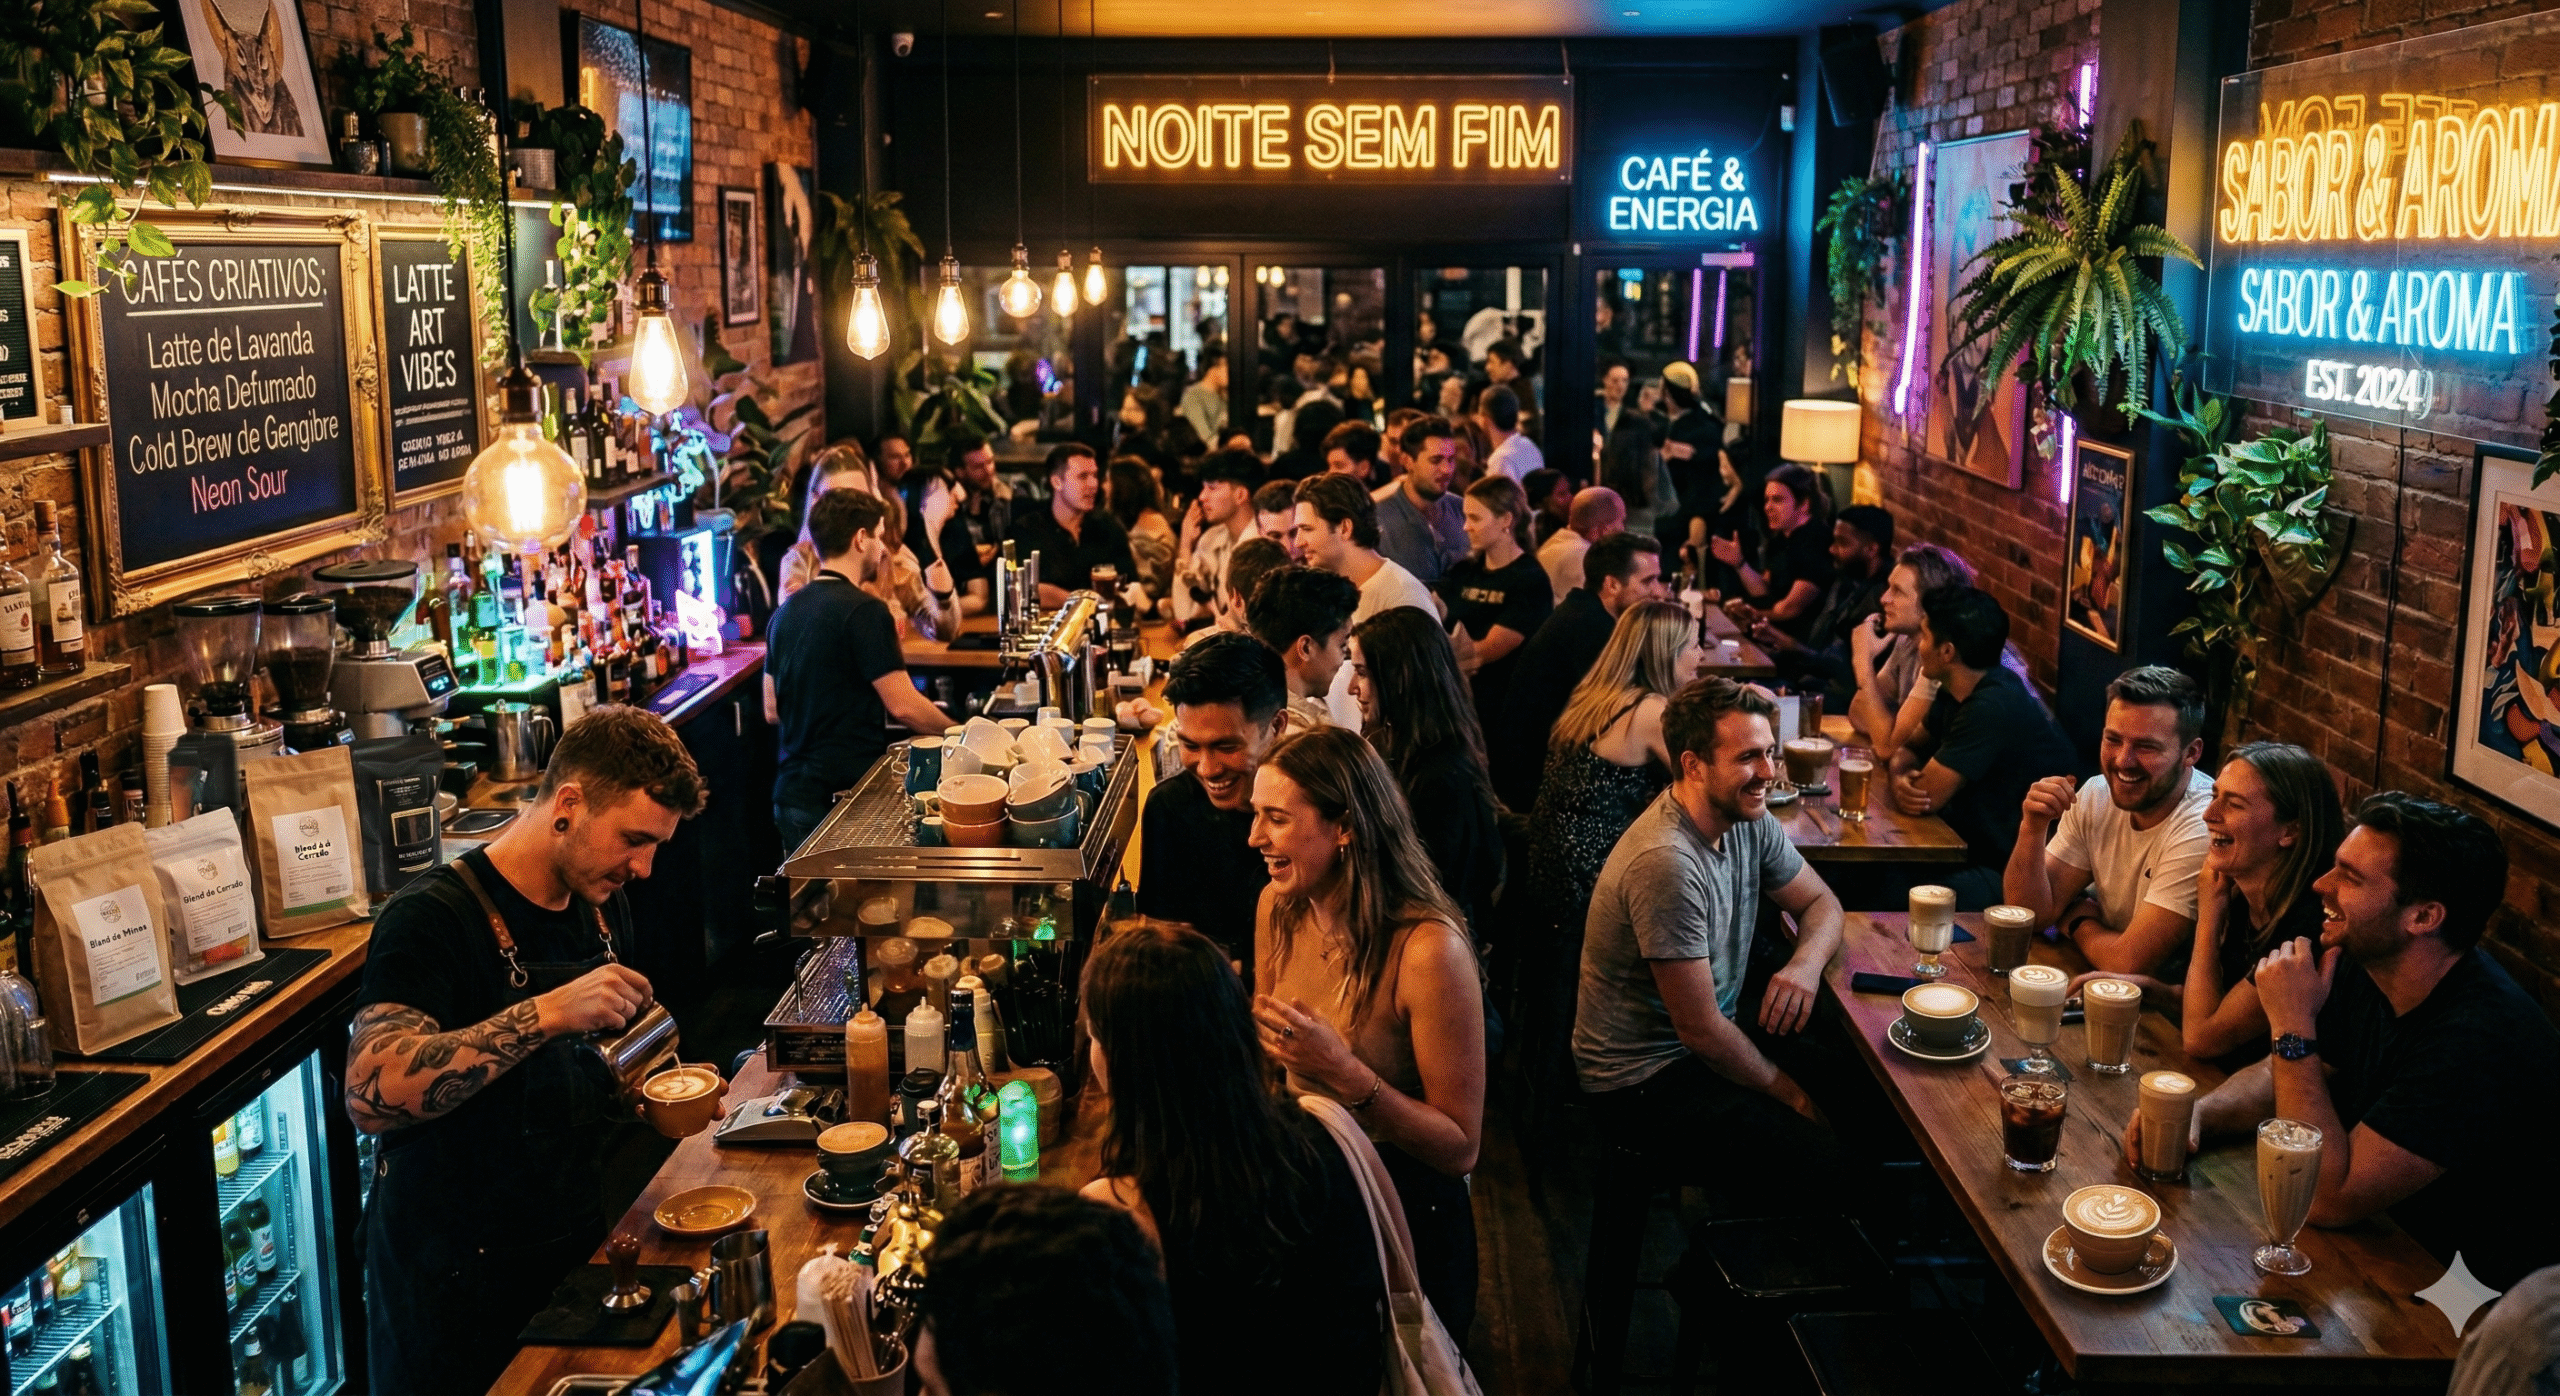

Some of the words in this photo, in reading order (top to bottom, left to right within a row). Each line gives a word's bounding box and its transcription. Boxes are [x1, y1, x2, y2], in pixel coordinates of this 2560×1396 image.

[1102, 104, 1292, 169] NOITE
[1304, 104, 1436, 169] SEM
[1452, 104, 1560, 169] FIM
[1621, 148, 1713, 192] CAFÉ
[1720, 156, 1746, 192] &
[2219, 128, 2352, 243] SABOR
[2354, 122, 2391, 242] &
[2393, 101, 2560, 241] AROM
[1609, 196, 1759, 231] ENERGIA
[120, 249, 203, 305] CAFÉS
[208, 257, 327, 301] CRIATIVOS:
[393, 263, 456, 304] LATTE
[408, 307, 446, 348] ART
[2237, 267, 2341, 340] SABOR
[2345, 269, 2374, 343] &
[2376, 269, 2518, 355] AROMA
[147, 332, 202, 369] Latte
[206, 327, 233, 364] de
[235, 320, 315, 361] Lavanda
[150, 376, 222, 420] Mocha
[225, 364, 317, 411] Defumado
[400, 349, 457, 392] VIBES
[2304, 358, 2354, 403] EST.
[129, 434, 178, 475] Cold
[181, 427, 232, 466] Brew
[237, 418, 261, 455] de
[264, 408, 340, 453] Gengibre
[191, 474, 243, 515] Neon
[246, 465, 289, 501] Sour
